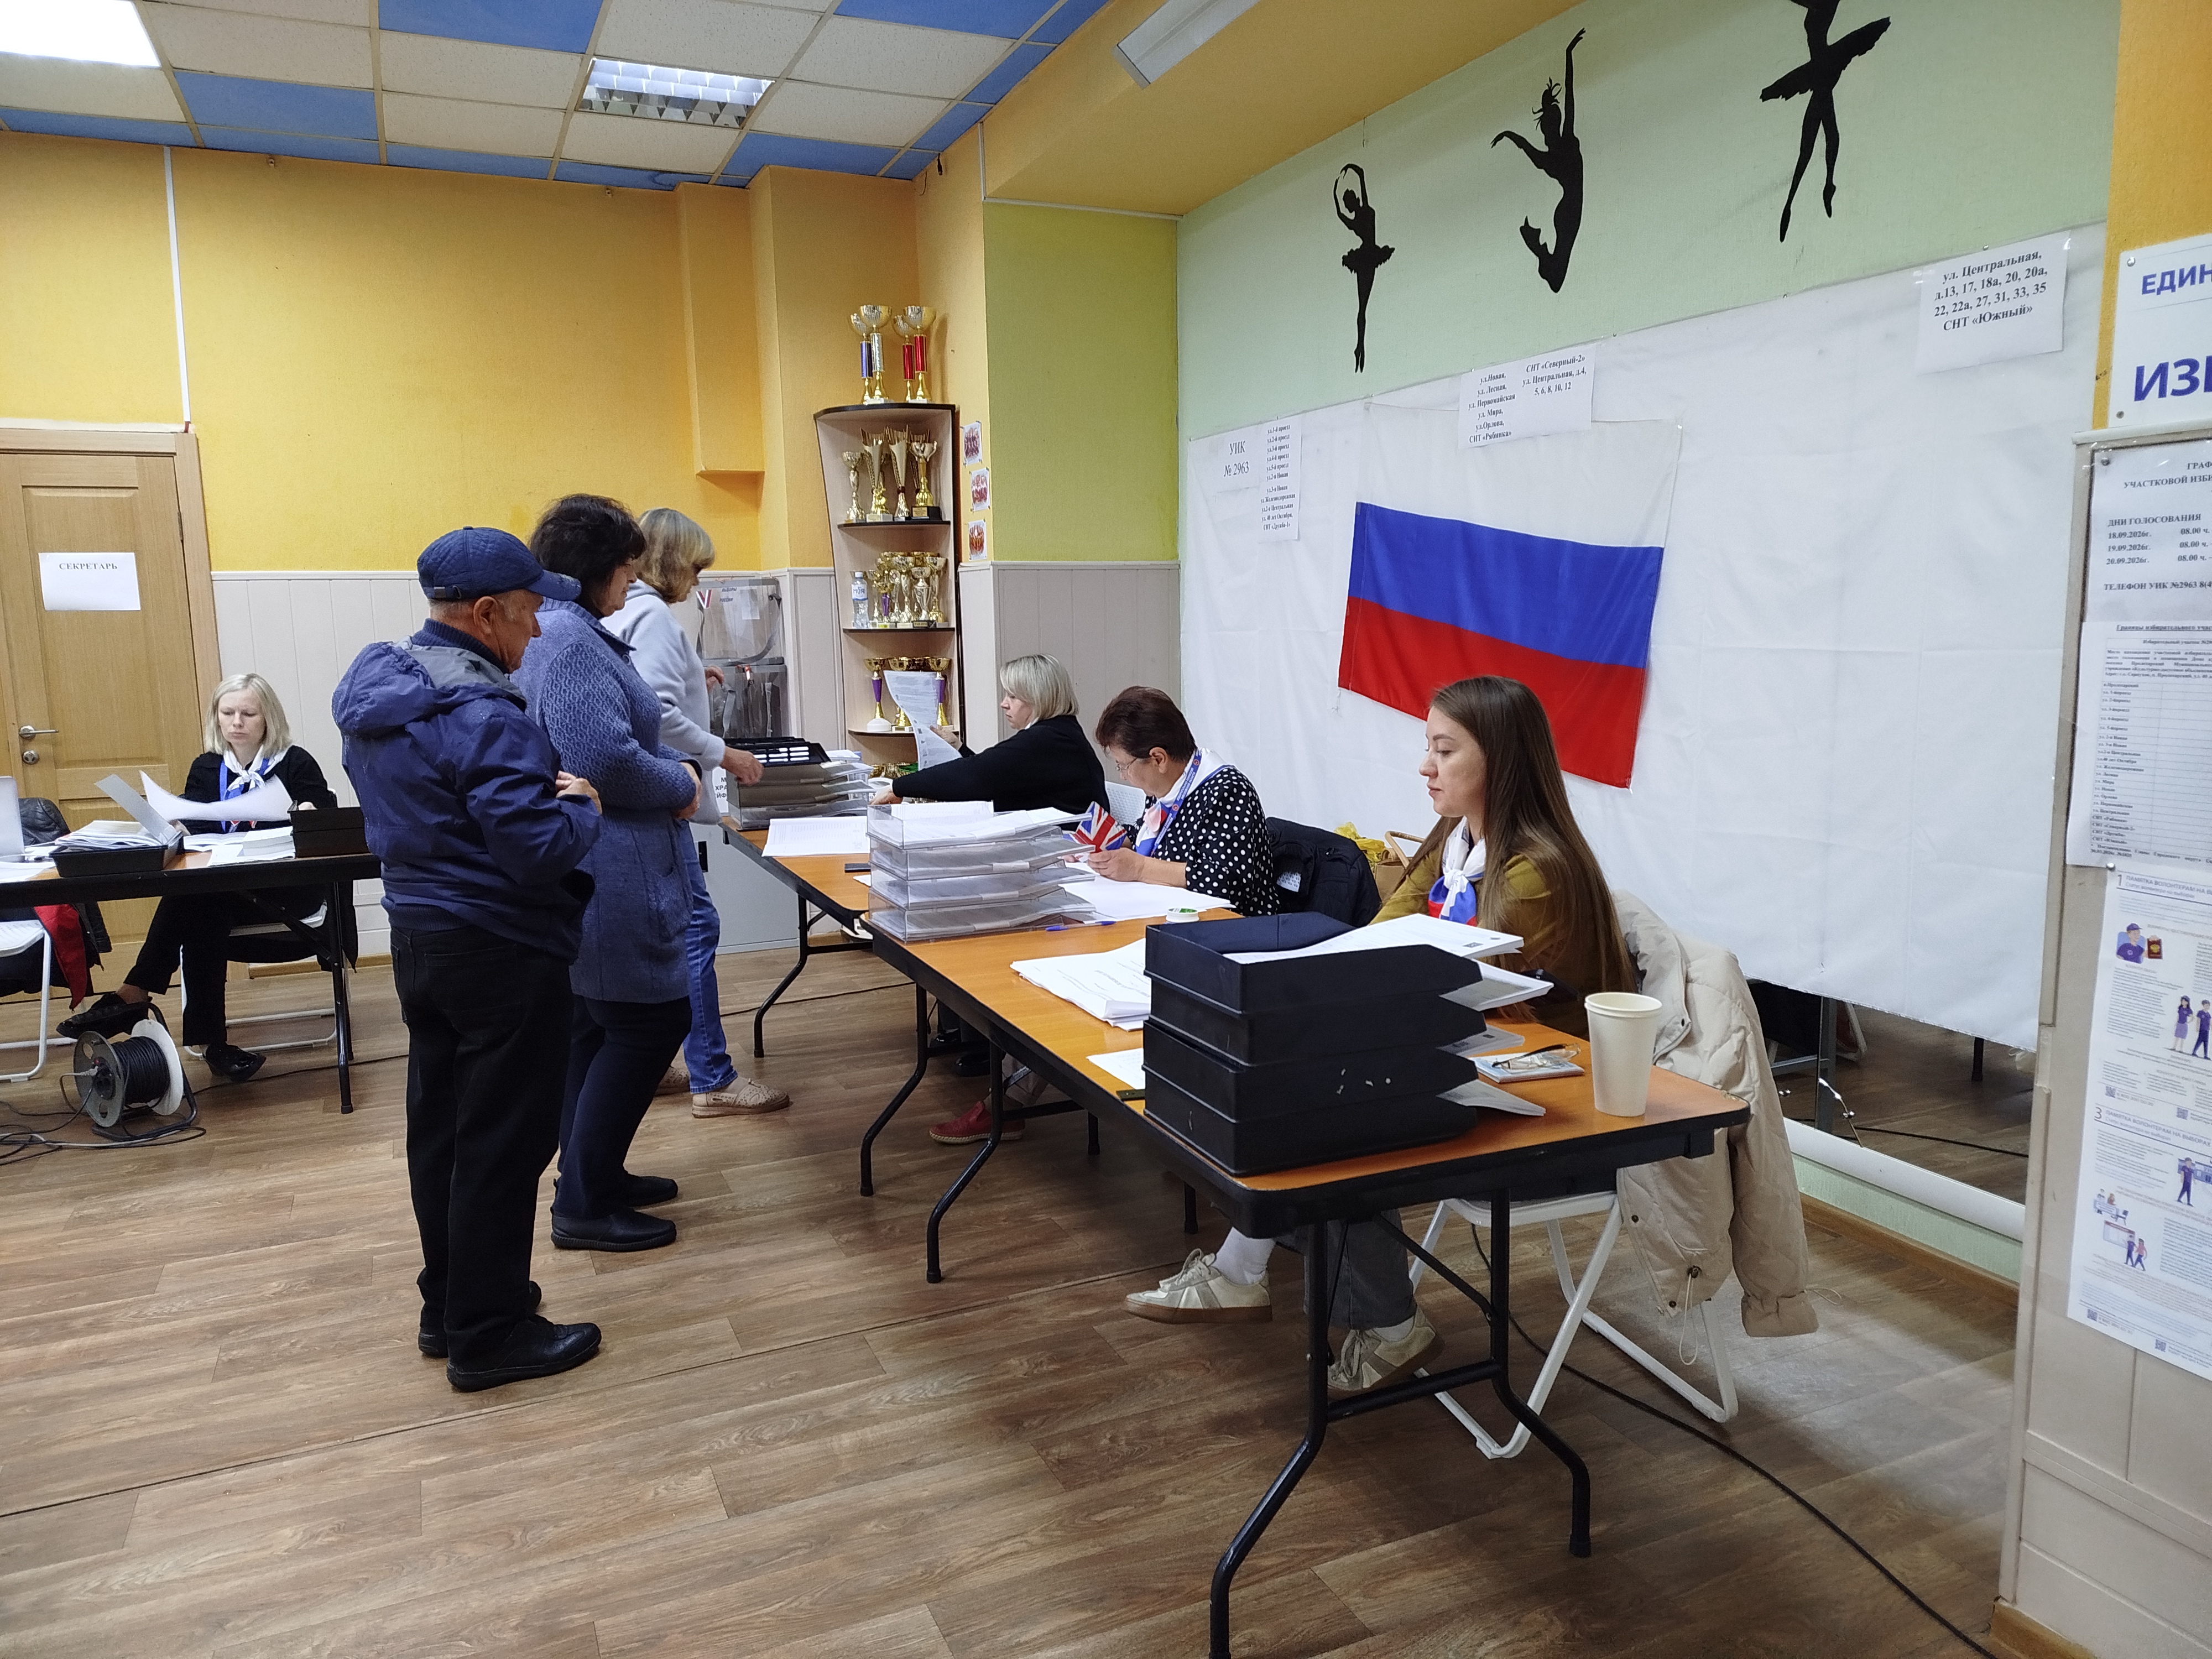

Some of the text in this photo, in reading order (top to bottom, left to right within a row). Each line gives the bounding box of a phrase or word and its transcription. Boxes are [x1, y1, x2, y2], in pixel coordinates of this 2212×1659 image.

[1942, 252, 2042, 284] ул. Центральная,
[1934, 266, 2048, 301] д.13, 17, 18а, 20, 20а,
[2141, 264, 2212, 295] ЕДИН
[1934, 282, 2047, 317] 22, 22а, 27, 31, 33, 35
[1943, 304, 2033, 331] СНТ «Южный»
[1526, 354, 1585, 373] СНТ «Северный-2»
[1522, 367, 1587, 387] ул. Центральная, д.4,
[1486, 384, 1507, 394] Лесная,
[1534, 387, 1540, 396] 5,
[1541, 387, 1546, 395] 6,
[1554, 384, 1563, 392] 10,
[1564, 382, 1572, 390] 12
[1477, 394, 1516, 408] Первомайская
[1478, 409, 1504, 420] ул. Мира,
[1469, 435, 1482, 443] СНТ
[1229, 441, 1246, 455] УИК
[1223, 461, 1249, 477] № 2963
[2187, 461, 2212, 470] ГРАФ
[2124, 475, 2188, 488] УЧАСТКОВОЙ
[2108, 514, 2201, 527] ДНИ ГОЛОСОВАНИЯ
[2104, 582, 2147, 591] ТЕЛЕФОН
[2169, 581, 2197, 589] №2963
